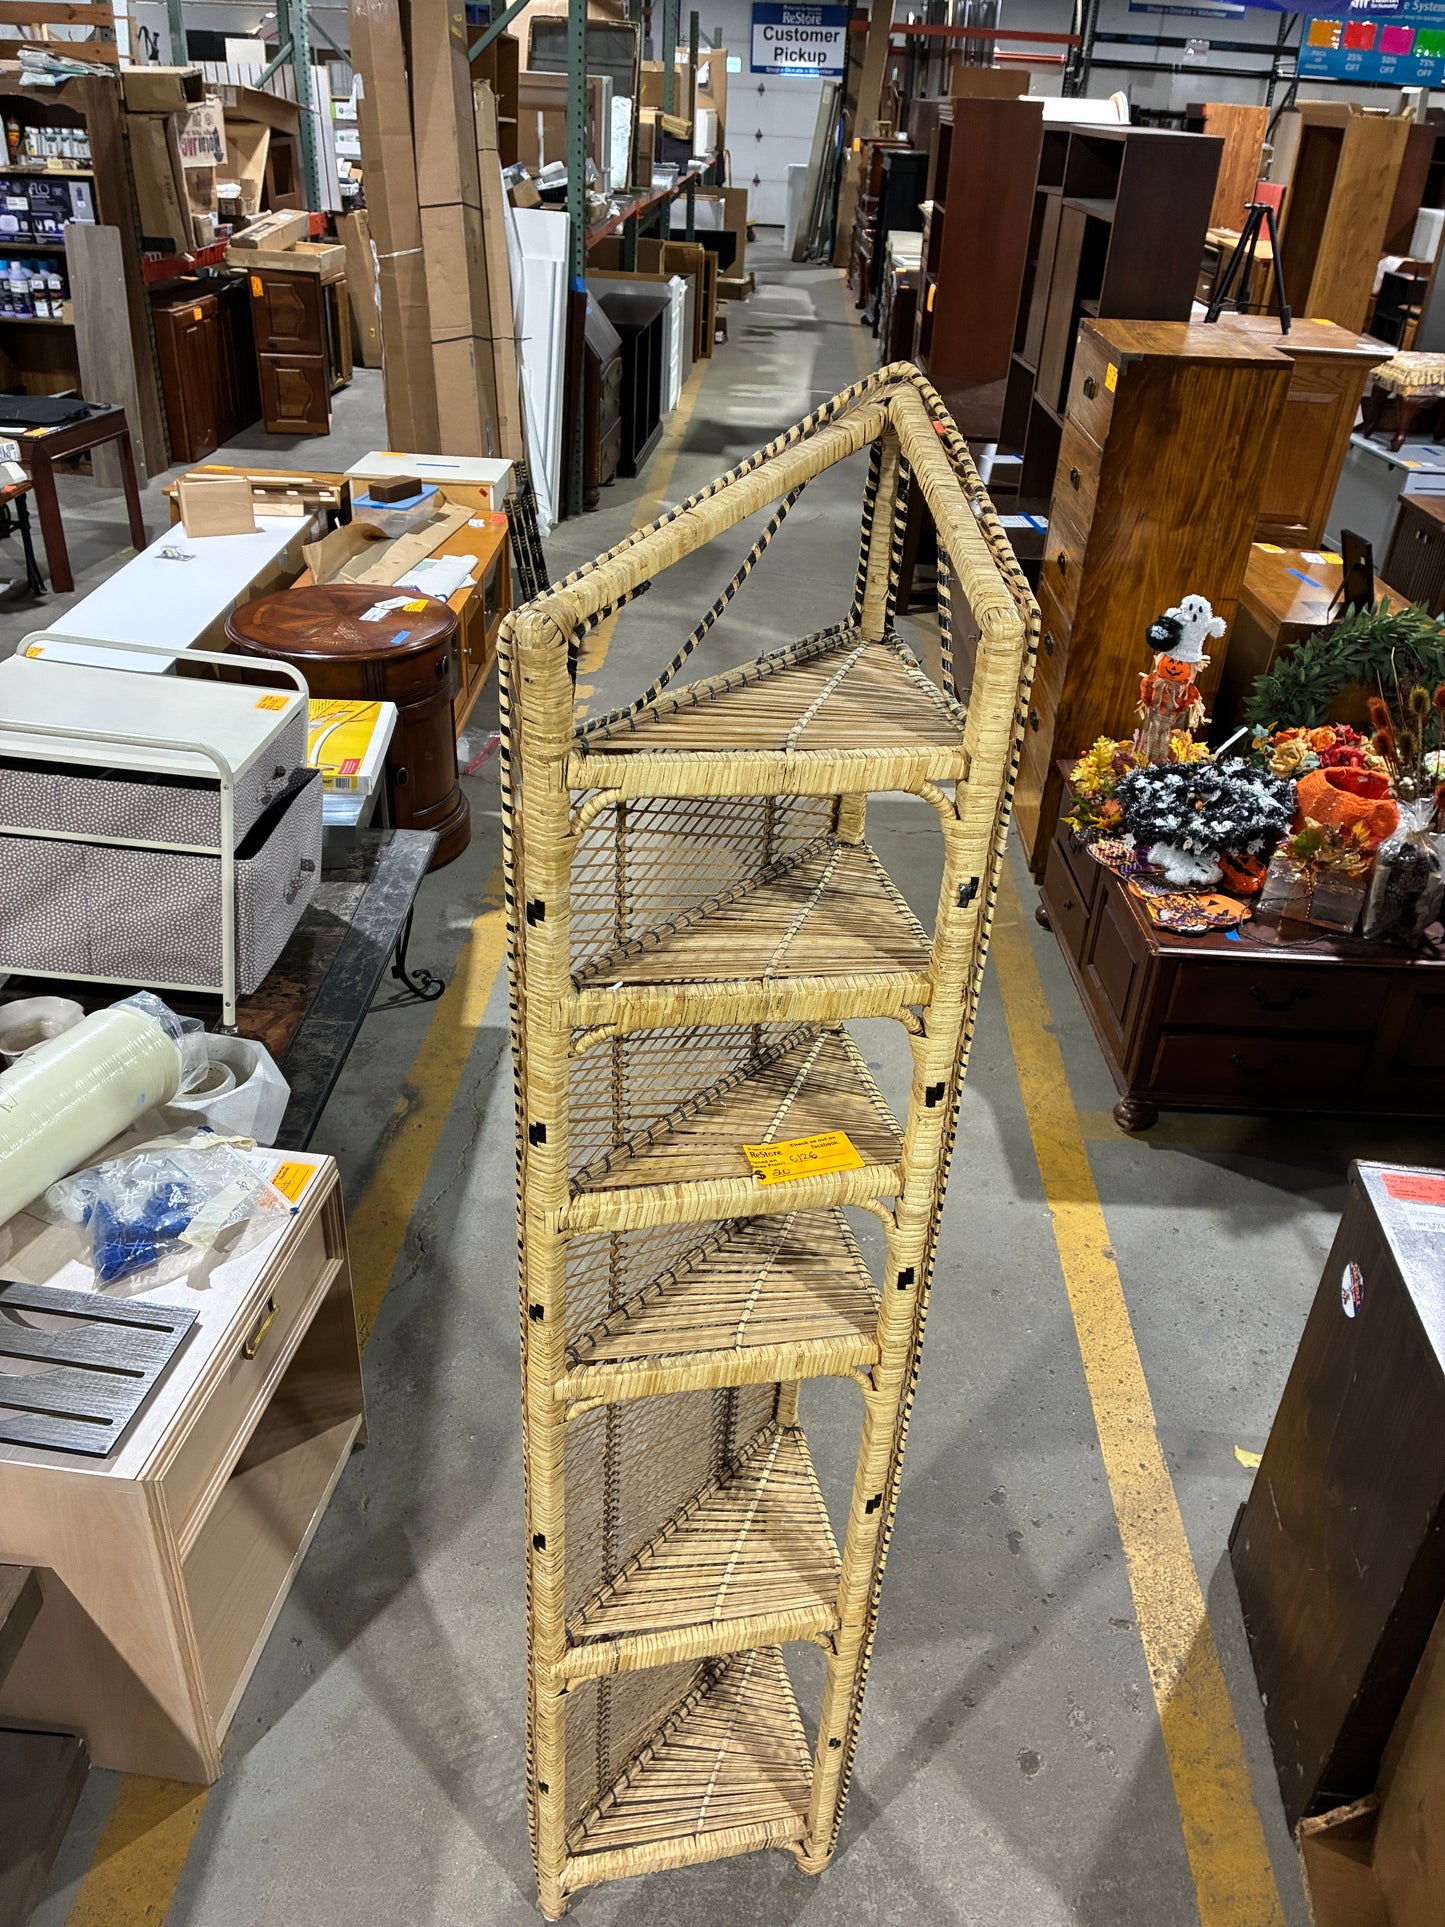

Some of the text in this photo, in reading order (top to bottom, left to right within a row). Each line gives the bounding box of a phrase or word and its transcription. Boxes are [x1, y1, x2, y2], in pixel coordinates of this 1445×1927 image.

[782, 11, 822, 24] ReStore
[763, 26, 840, 42] Customer
[774, 47, 827, 65] Pickup
[1344, 63, 1361, 71] OFF
[1379, 66, 1396, 74] OFF
[1416, 69, 1433, 77] OFF
[749, 1150, 782, 1159] ReStore
[772, 1168, 791, 1177] 20
